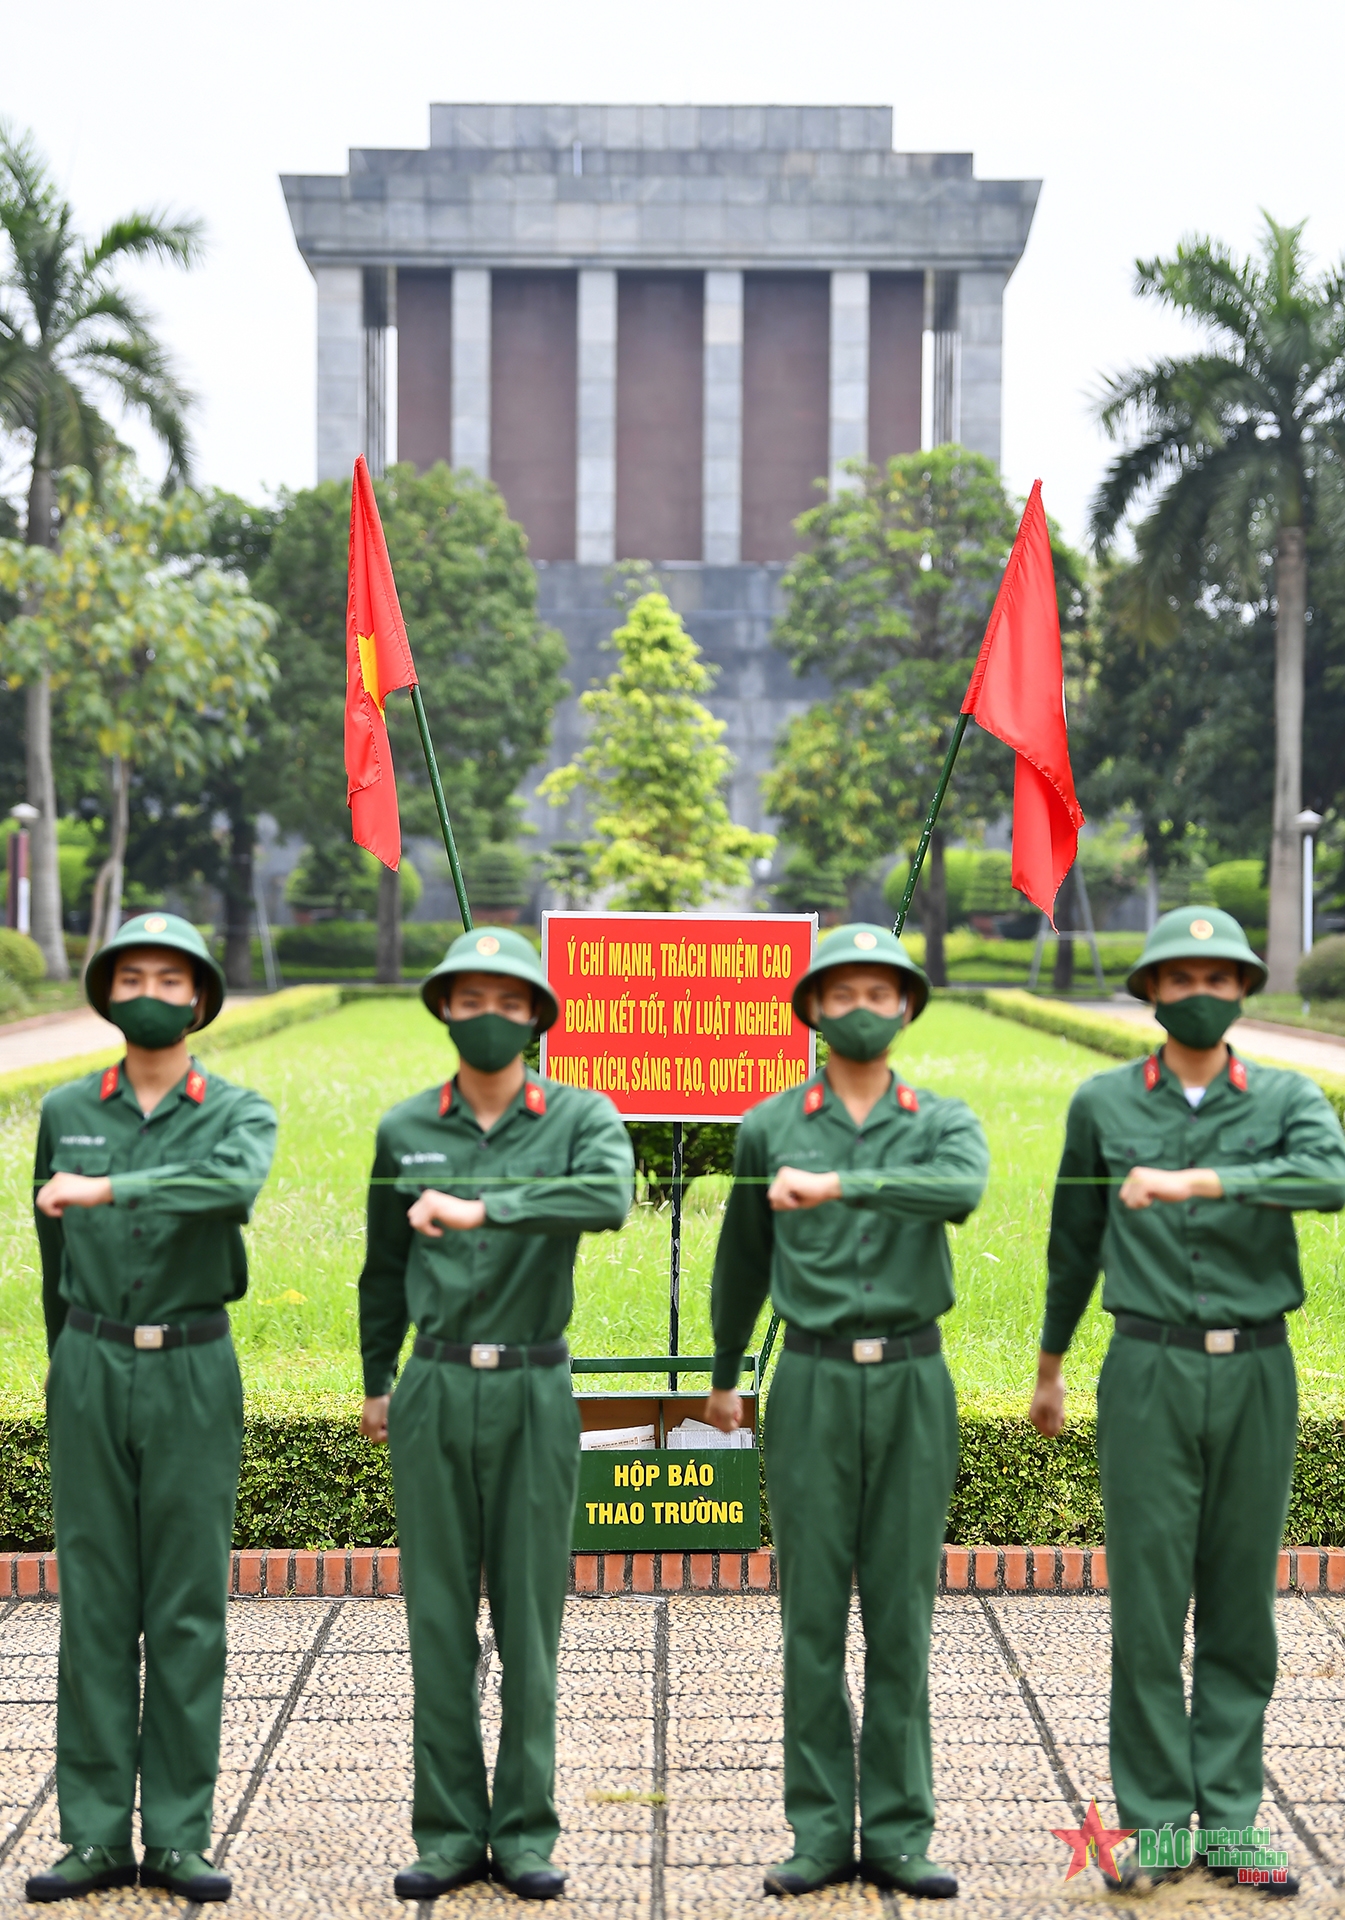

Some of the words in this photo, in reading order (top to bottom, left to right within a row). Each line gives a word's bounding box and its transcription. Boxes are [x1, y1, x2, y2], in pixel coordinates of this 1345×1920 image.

[580, 936, 606, 976] CHÍ
[608, 942, 657, 982] MẠNH,
[660, 936, 707, 978] TRÁCH
[711, 938, 758, 984] NHIỆM
[762, 944, 792, 979] CAO
[565, 993, 606, 1034] ĐOÀN
[609, 991, 636, 1034] KẾT
[640, 992, 668, 1038] TỐT,
[673, 988, 693, 1035] KỶ
[696, 995, 731, 1041] LUẬT
[735, 996, 792, 1036] NGHIÊM
[675, 1057, 706, 1097] TẠO,
[709, 1051, 754, 1096] QUYẾT
[614, 1459, 660, 1492] HỘP
[668, 1459, 714, 1487] BÁO
[585, 1502, 645, 1525] THAO
[651, 1496, 744, 1525] TRƯỜNG
